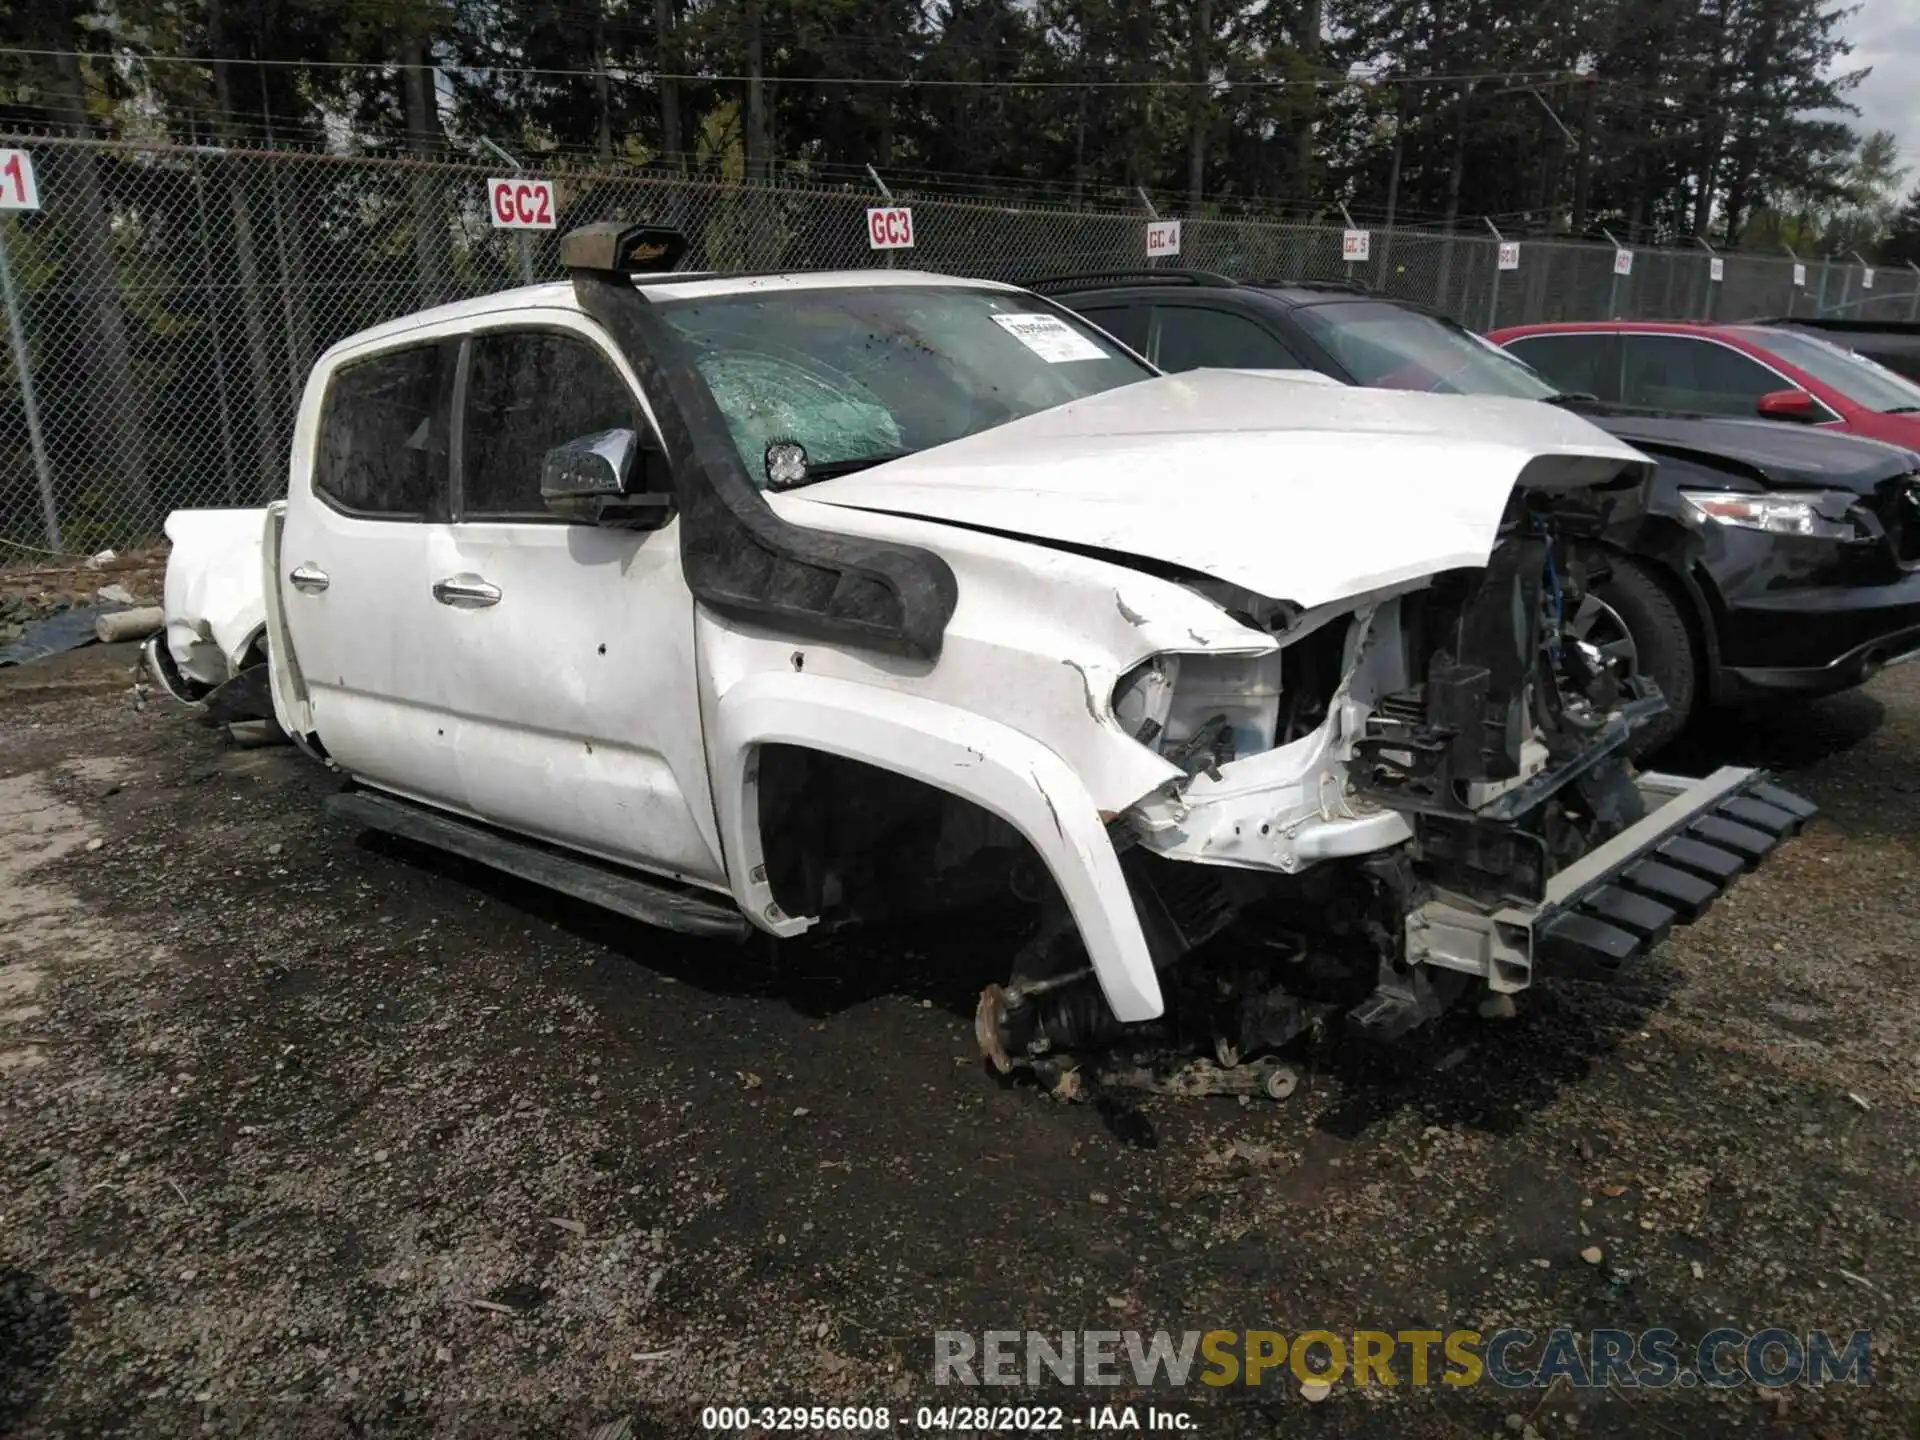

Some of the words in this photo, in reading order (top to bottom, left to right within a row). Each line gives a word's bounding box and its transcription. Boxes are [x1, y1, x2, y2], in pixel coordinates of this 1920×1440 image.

[0, 153, 27, 203] 1
[494, 183, 552, 224] GC2
[870, 211, 911, 245] GC3
